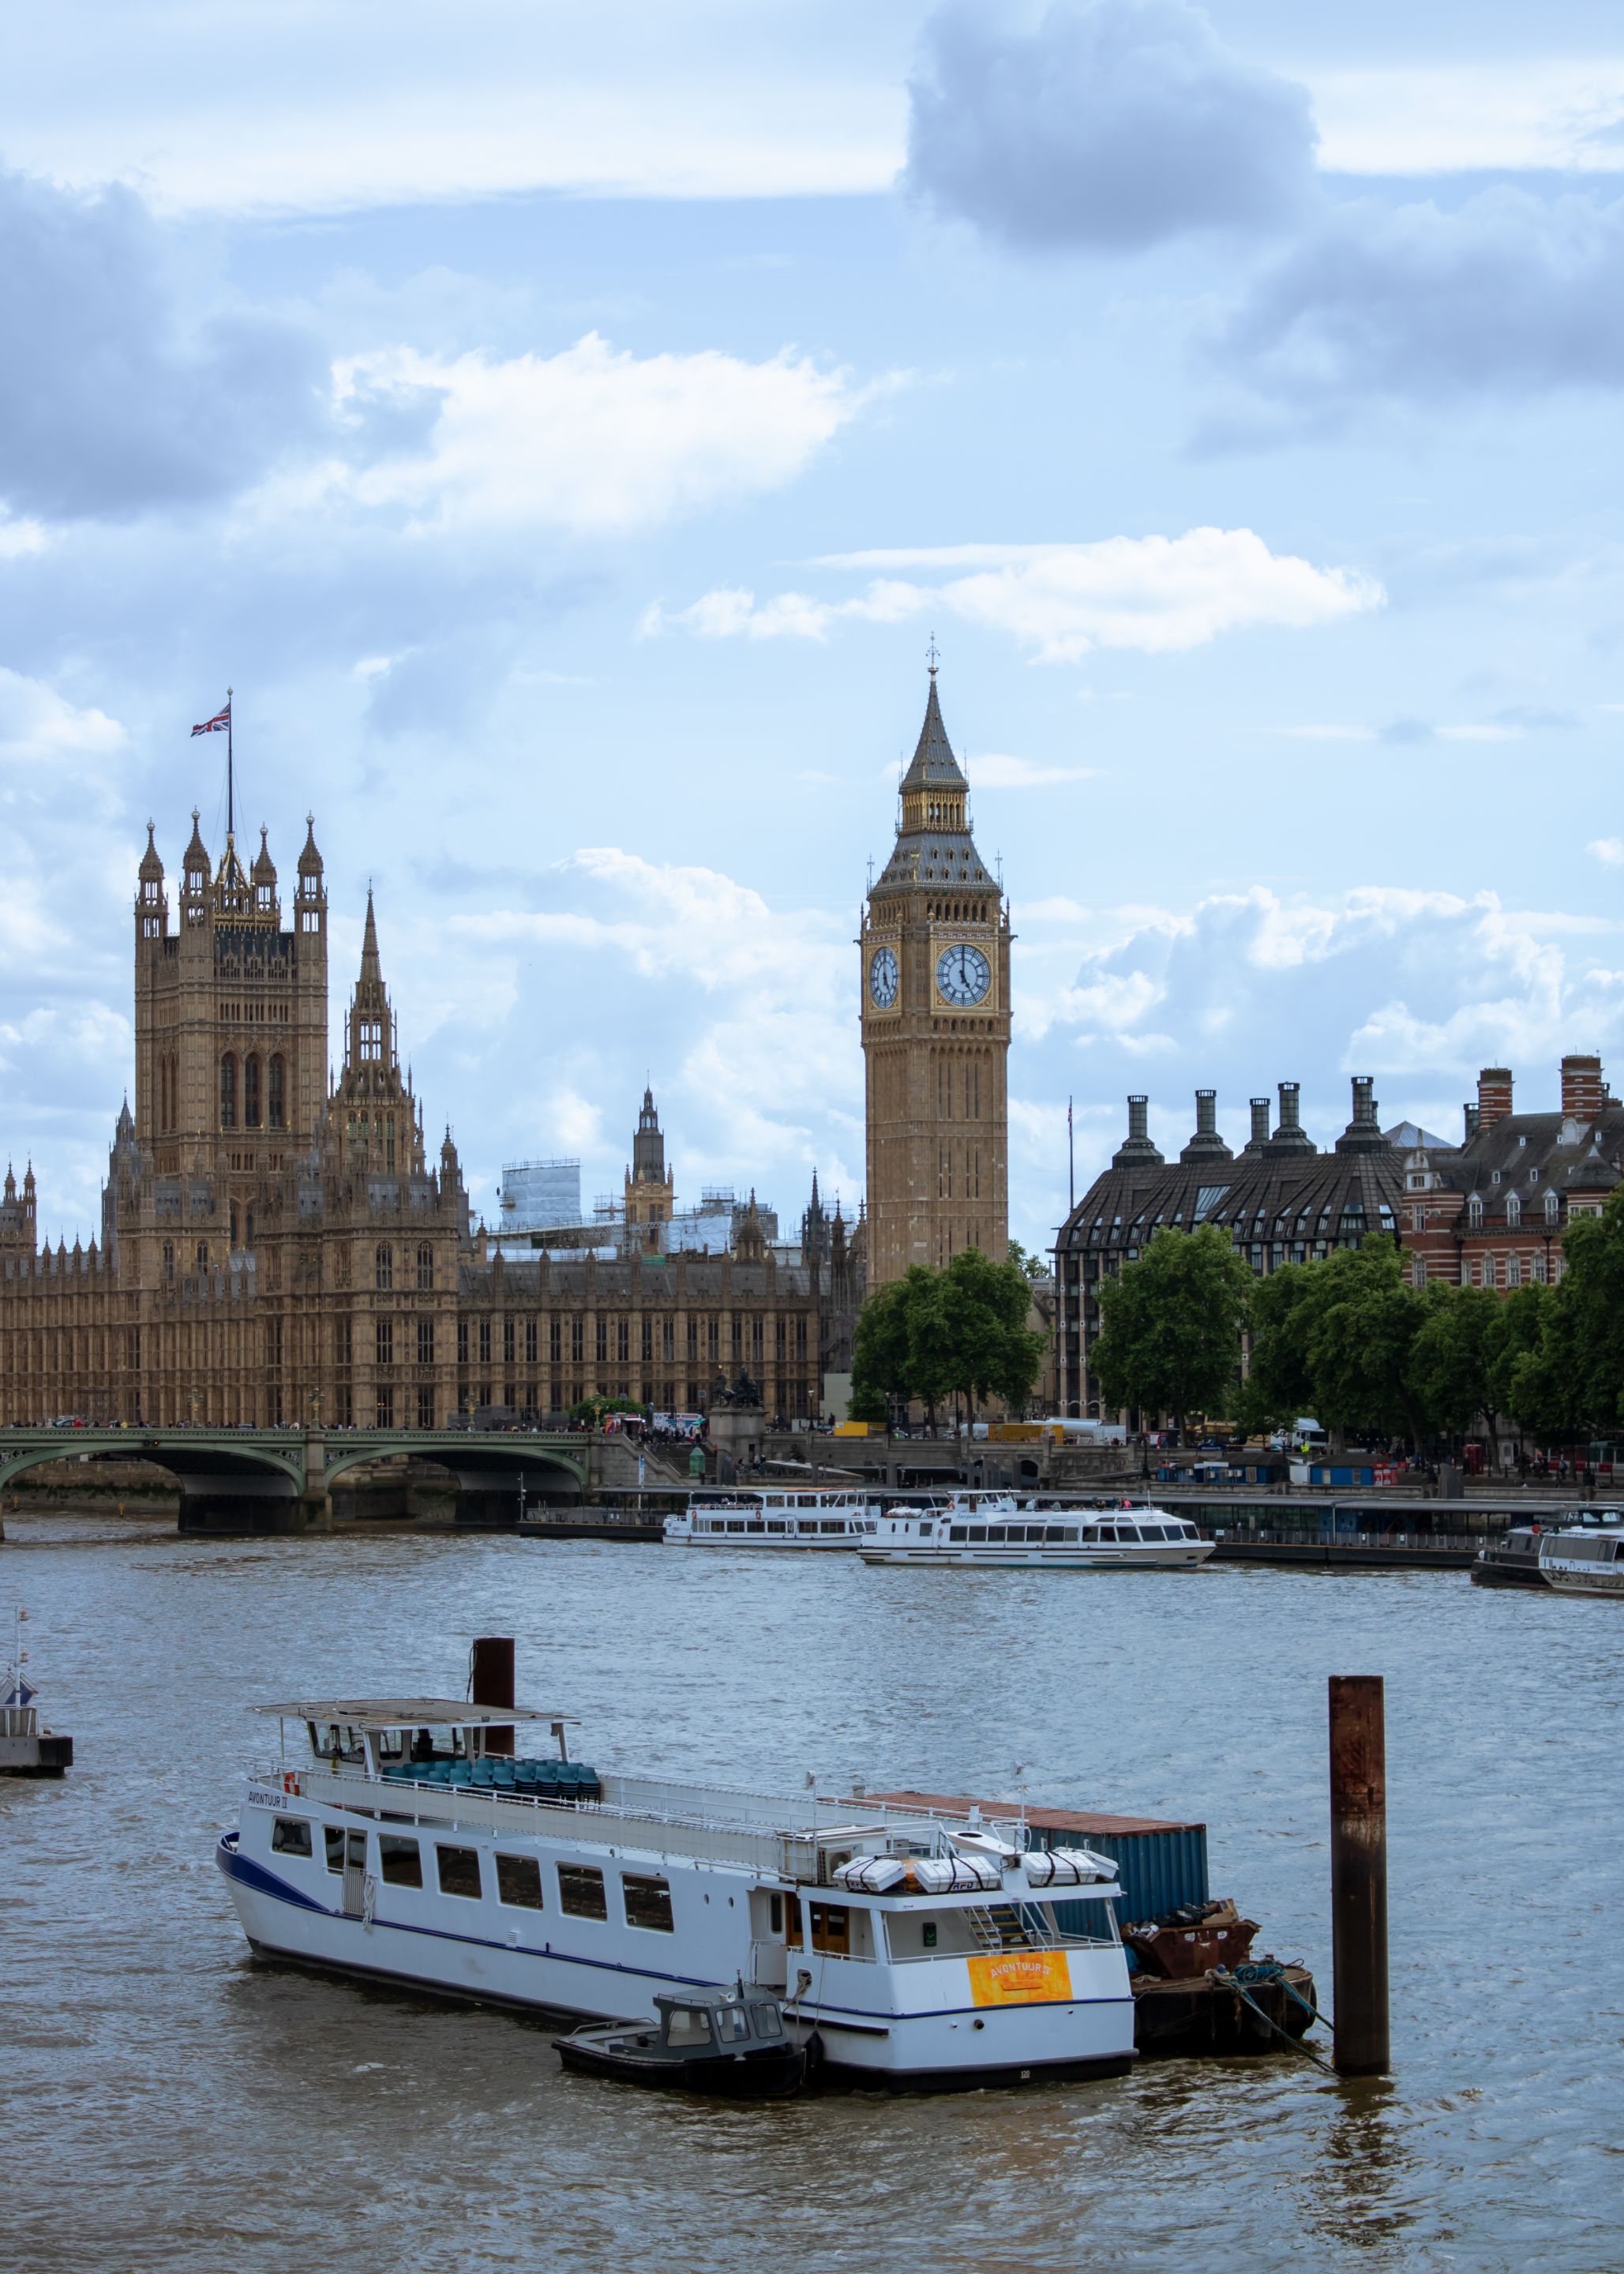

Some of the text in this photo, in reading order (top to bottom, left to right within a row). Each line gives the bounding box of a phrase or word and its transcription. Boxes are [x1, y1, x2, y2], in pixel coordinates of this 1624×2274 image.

[248, 1791, 288, 1809] AVONTUUR IV
[991, 1961, 1053, 1978] AVONTUUR IV
